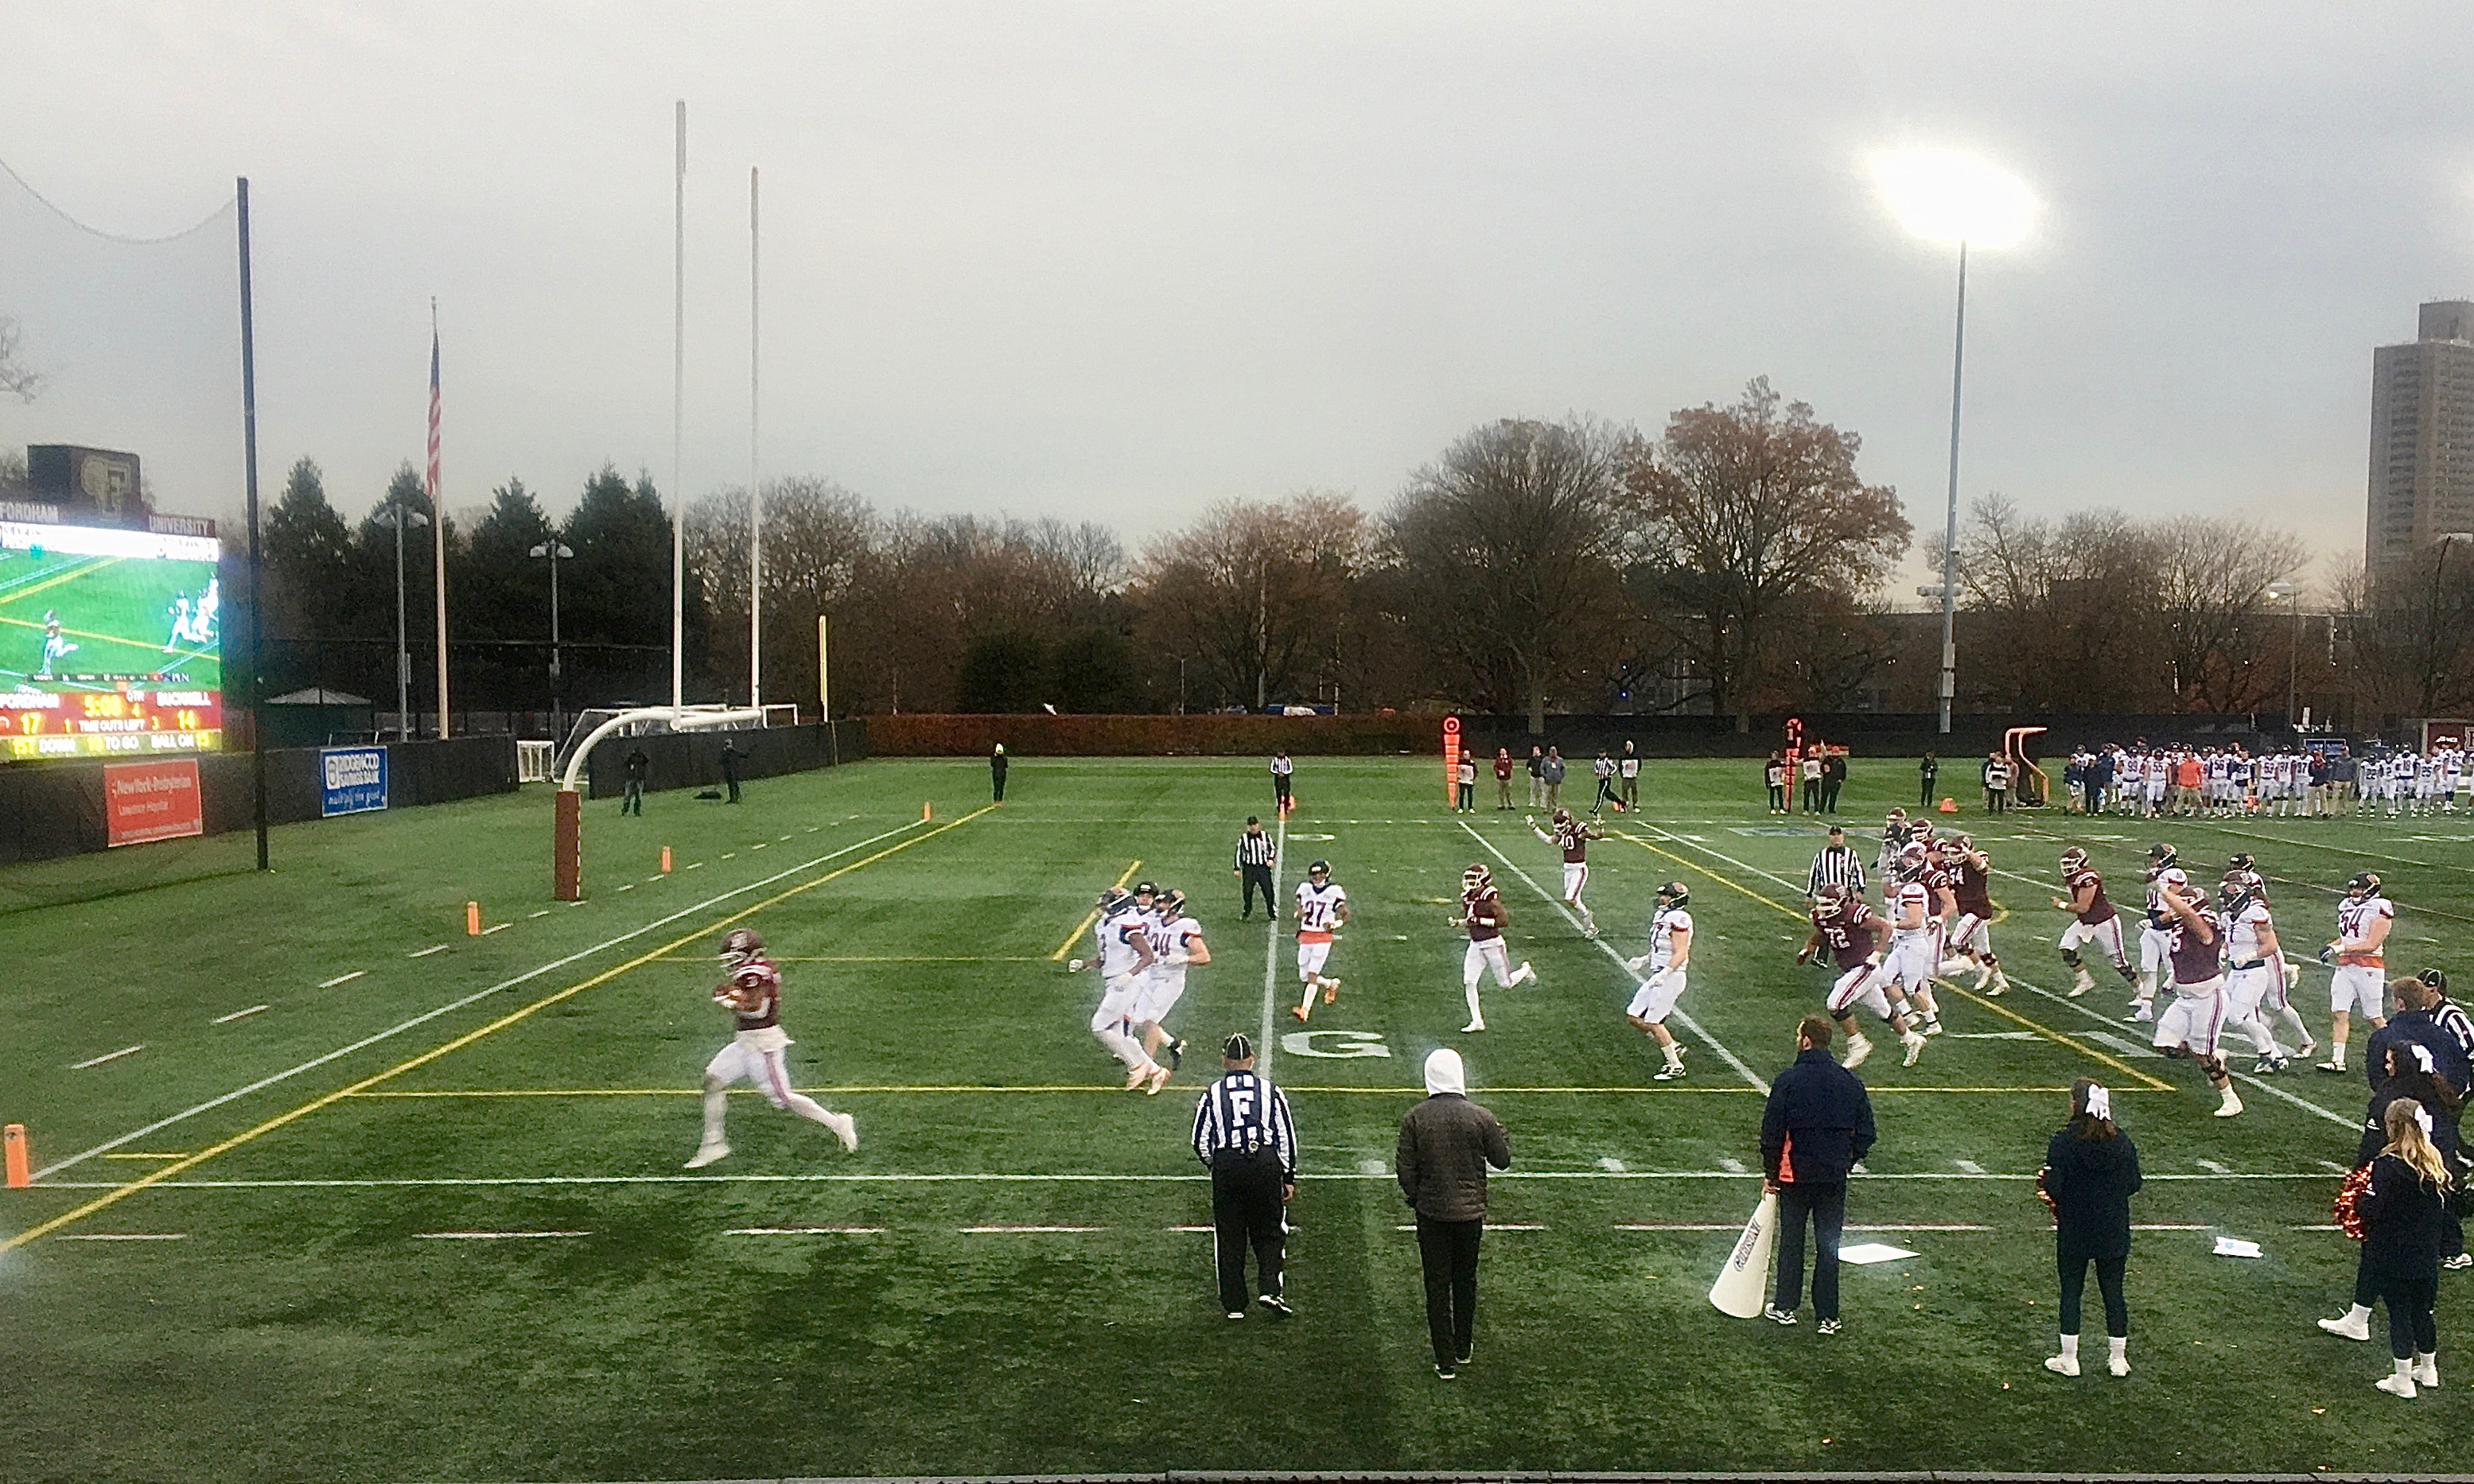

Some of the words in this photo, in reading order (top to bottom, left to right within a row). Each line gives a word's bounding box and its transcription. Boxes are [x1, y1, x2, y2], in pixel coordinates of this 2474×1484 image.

[148, 514, 208, 536] UNIVERSITY
[0, 693, 60, 709] FORDHAM
[156, 691, 212, 706] BUCKNELL
[20, 712, 41, 735] 17
[177, 709, 196, 729] 14
[38, 737, 76, 753] DOWN
[103, 736, 120, 751] TO
[121, 734, 139, 750] GO
[150, 733, 177, 748] BALL
[177, 732, 194, 748] ON
[1304, 900, 1327, 927] 27
[2340, 907, 2366, 938] 54
[1824, 926, 1851, 949] 72
[1281, 1031, 1391, 1058] G
[1229, 1090, 1255, 1127] F
